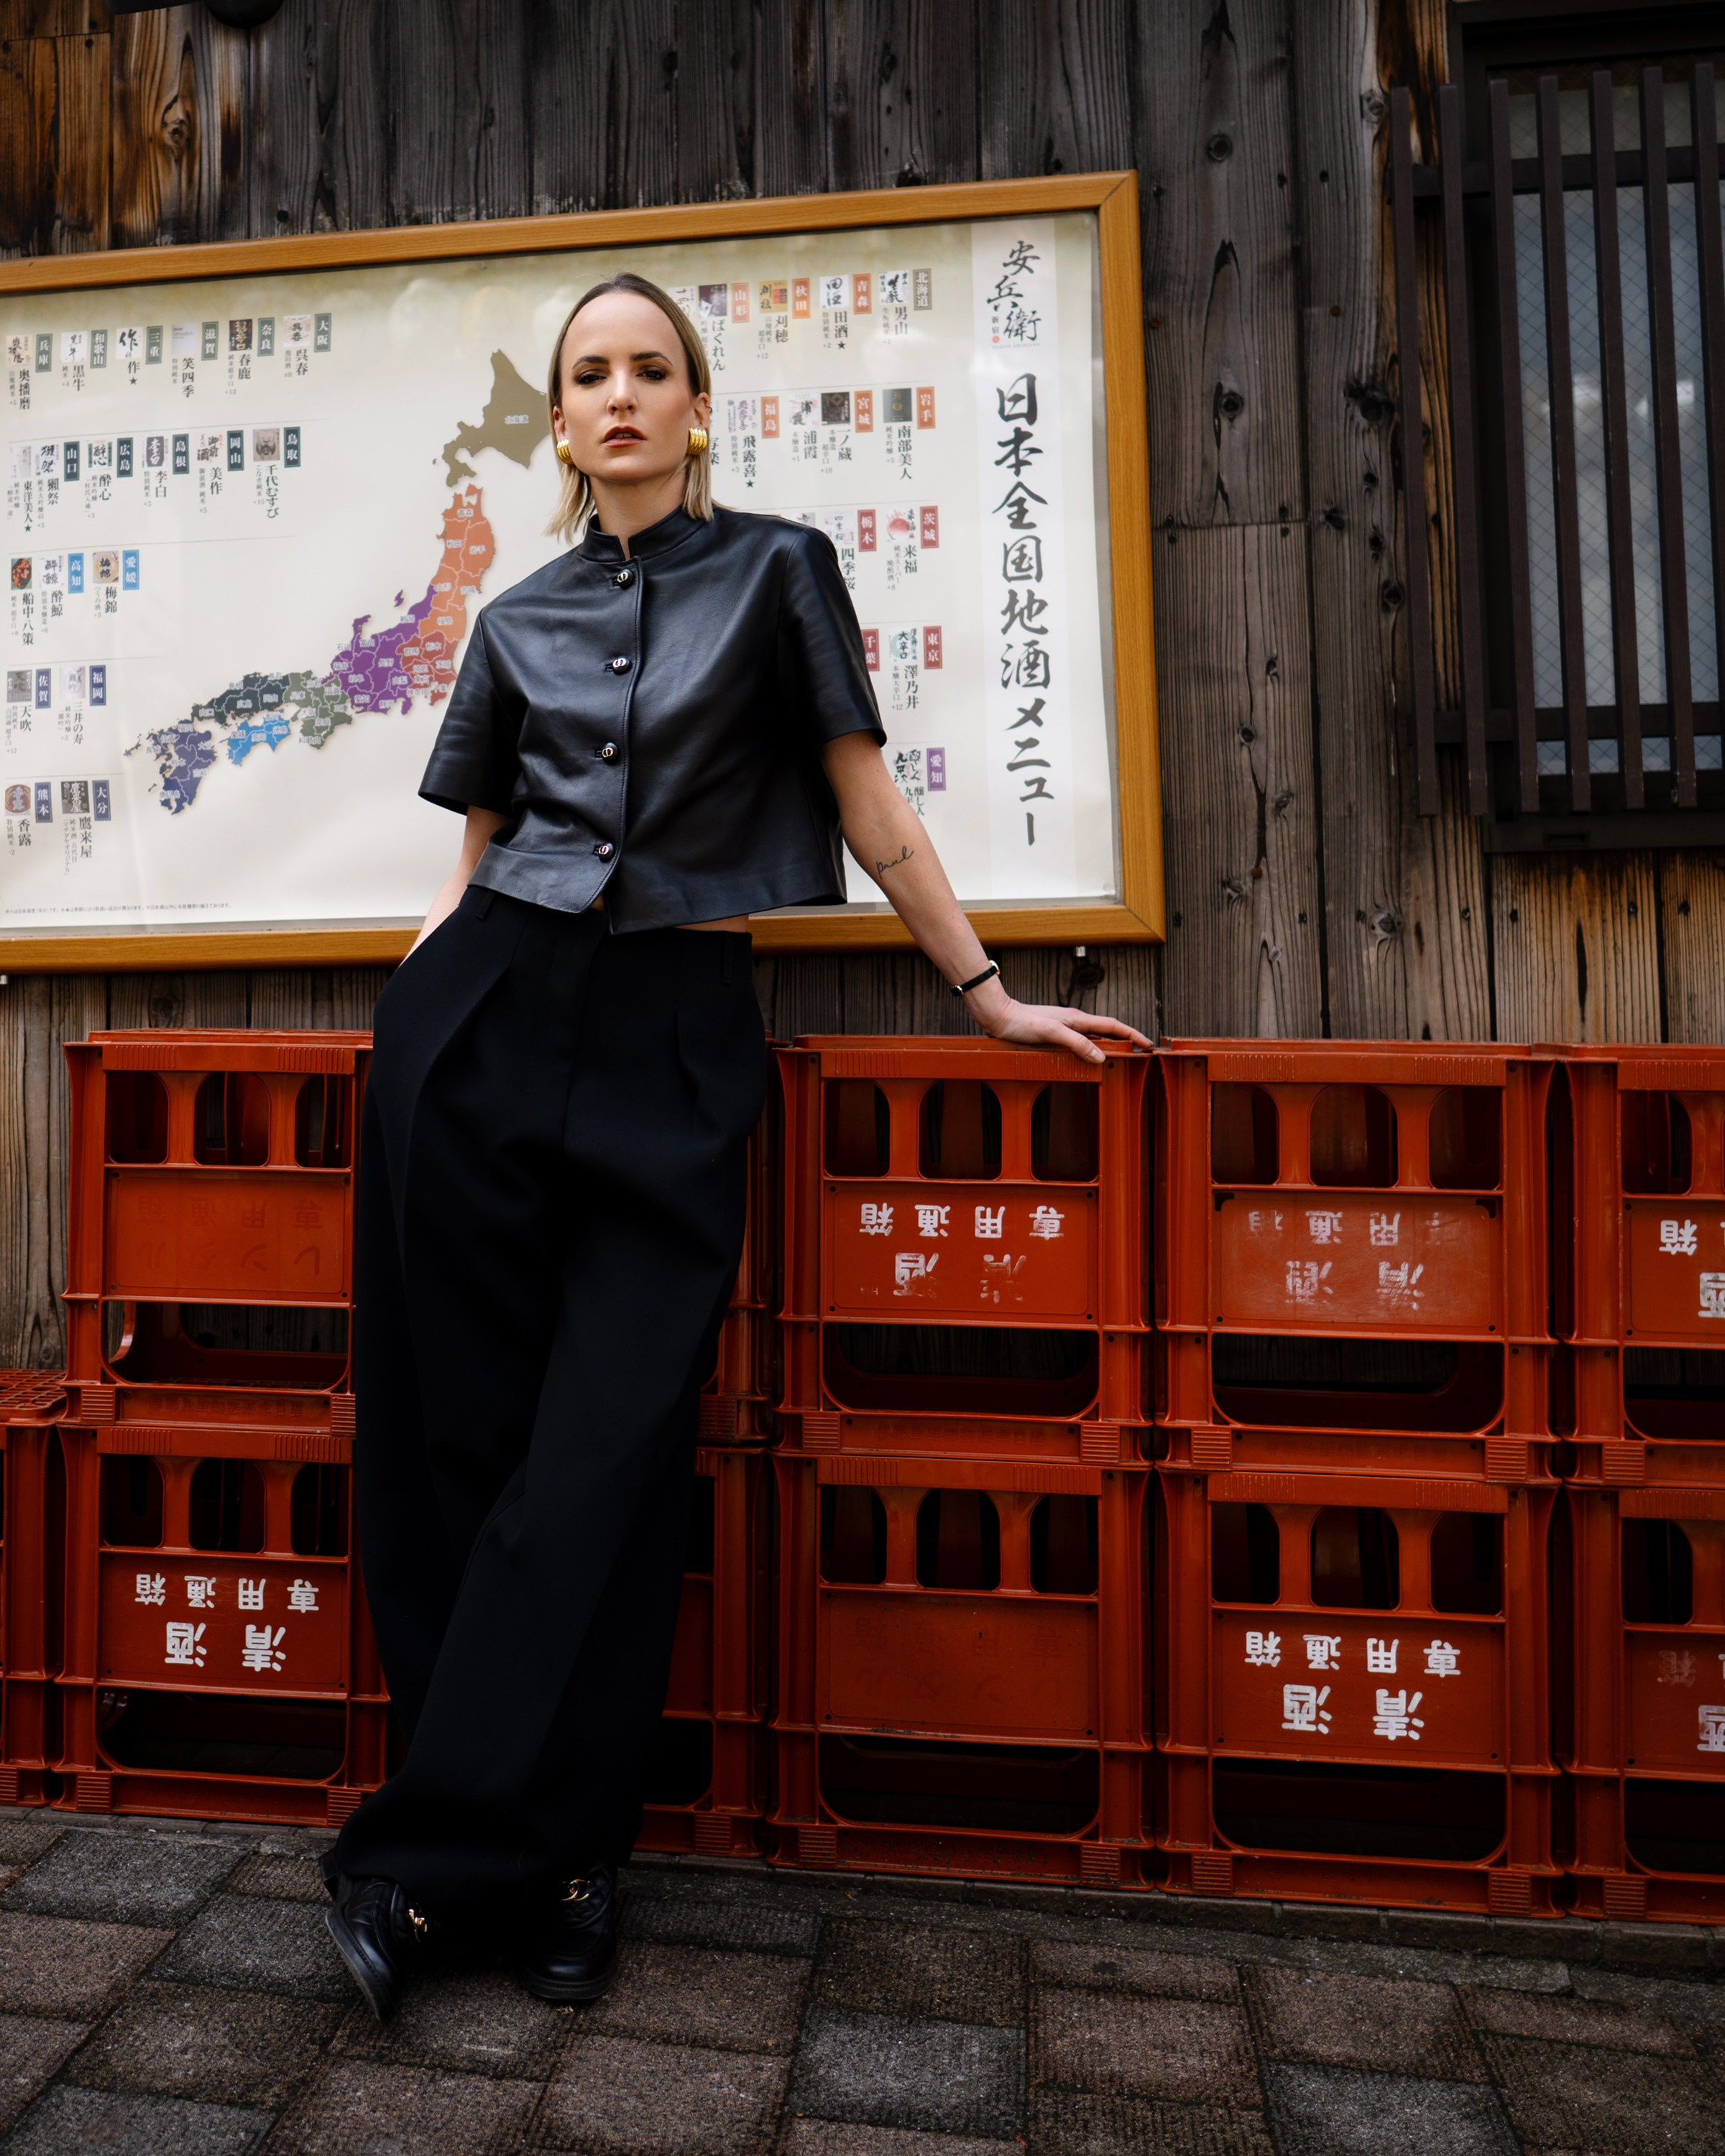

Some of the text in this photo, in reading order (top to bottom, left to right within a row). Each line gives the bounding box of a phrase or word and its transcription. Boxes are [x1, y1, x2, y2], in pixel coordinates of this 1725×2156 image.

[735, 290, 747, 316] 山形
[796, 285, 807, 311] 秋田
[857, 280, 868, 308] 青森
[916, 272, 929, 307] 北海道
[986, 240, 1041, 341] 安兵衛
[318, 320, 329, 346] 大阪
[775, 315, 788, 344] 刈穂
[834, 311, 848, 338] 田酒
[895, 306, 908, 335] 男山
[93, 332, 105, 366] 和歌山
[150, 332, 160, 356] 三重
[206, 328, 216, 354] 滋賀
[260, 323, 272, 350] 奈良
[712, 319, 726, 371] ばくれん
[39, 340, 50, 365] 兵庫
[238, 354, 252, 379] 春鹿
[295, 349, 309, 376] 呉春
[73, 364, 85, 391] 黒牛
[128, 360, 141, 374] 作
[181, 356, 196, 398] 笑四季
[19, 369, 30, 410] 奥播磨
[765, 404, 776, 431] 福島
[858, 397, 870, 425] 宮城
[920, 394, 932, 423] 岩手
[119, 444, 131, 471] 広島
[175, 441, 186, 468] 島根
[230, 437, 240, 464] 岡山
[287, 433, 298, 460] 鳥取
[743, 435, 756, 478] 飛露喜
[804, 430, 818, 460] 浦霞
[837, 428, 852, 461] 一ノ蔵
[898, 425, 913, 480] 南部美人
[68, 448, 77, 474] 山口
[47, 477, 59, 505] 獺祭
[99, 474, 112, 500] 酔心
[155, 470, 167, 497] 李白
[210, 467, 222, 494] 美作
[266, 464, 279, 519] 千代むすび
[24, 480, 33, 523] 東洋美人
[862, 516, 874, 545] 栃木
[923, 513, 936, 541] 茨城
[125, 556, 137, 584] 愛媛
[842, 548, 855, 590] 四季桜
[904, 545, 917, 573] 来福
[72, 561, 80, 586] 高知
[51, 589, 63, 617] 酔鯨
[105, 586, 117, 614] 梅錦
[992, 373, 1054, 847] 日本全国地酒メニュー
[22, 592, 34, 645] 船中八策
[864, 636, 876, 664] 千葉
[898, 631, 908, 660] 大辛口
[927, 632, 939, 661] 東京
[39, 675, 48, 702] 佐賀
[93, 672, 103, 699] 福岡
[904, 665, 919, 710] 澤乃井
[20, 704, 32, 732] 天吹
[73, 701, 83, 745] 三井の寿
[930, 755, 942, 783] 愛知
[37, 789, 49, 816] 熊本
[96, 787, 108, 814] 大分
[914, 786, 924, 816] 醸し人
[18, 819, 32, 847] 香露
[79, 816, 92, 858] 鷹来屋
[875, 845, 914, 880] paul
[135, 1572, 319, 1613] 専用通箱
[165, 1621, 286, 1672] 清酒
[1245, 1630, 1460, 1678] 専用通箱
[1282, 1684, 1425, 1741] 清酒
